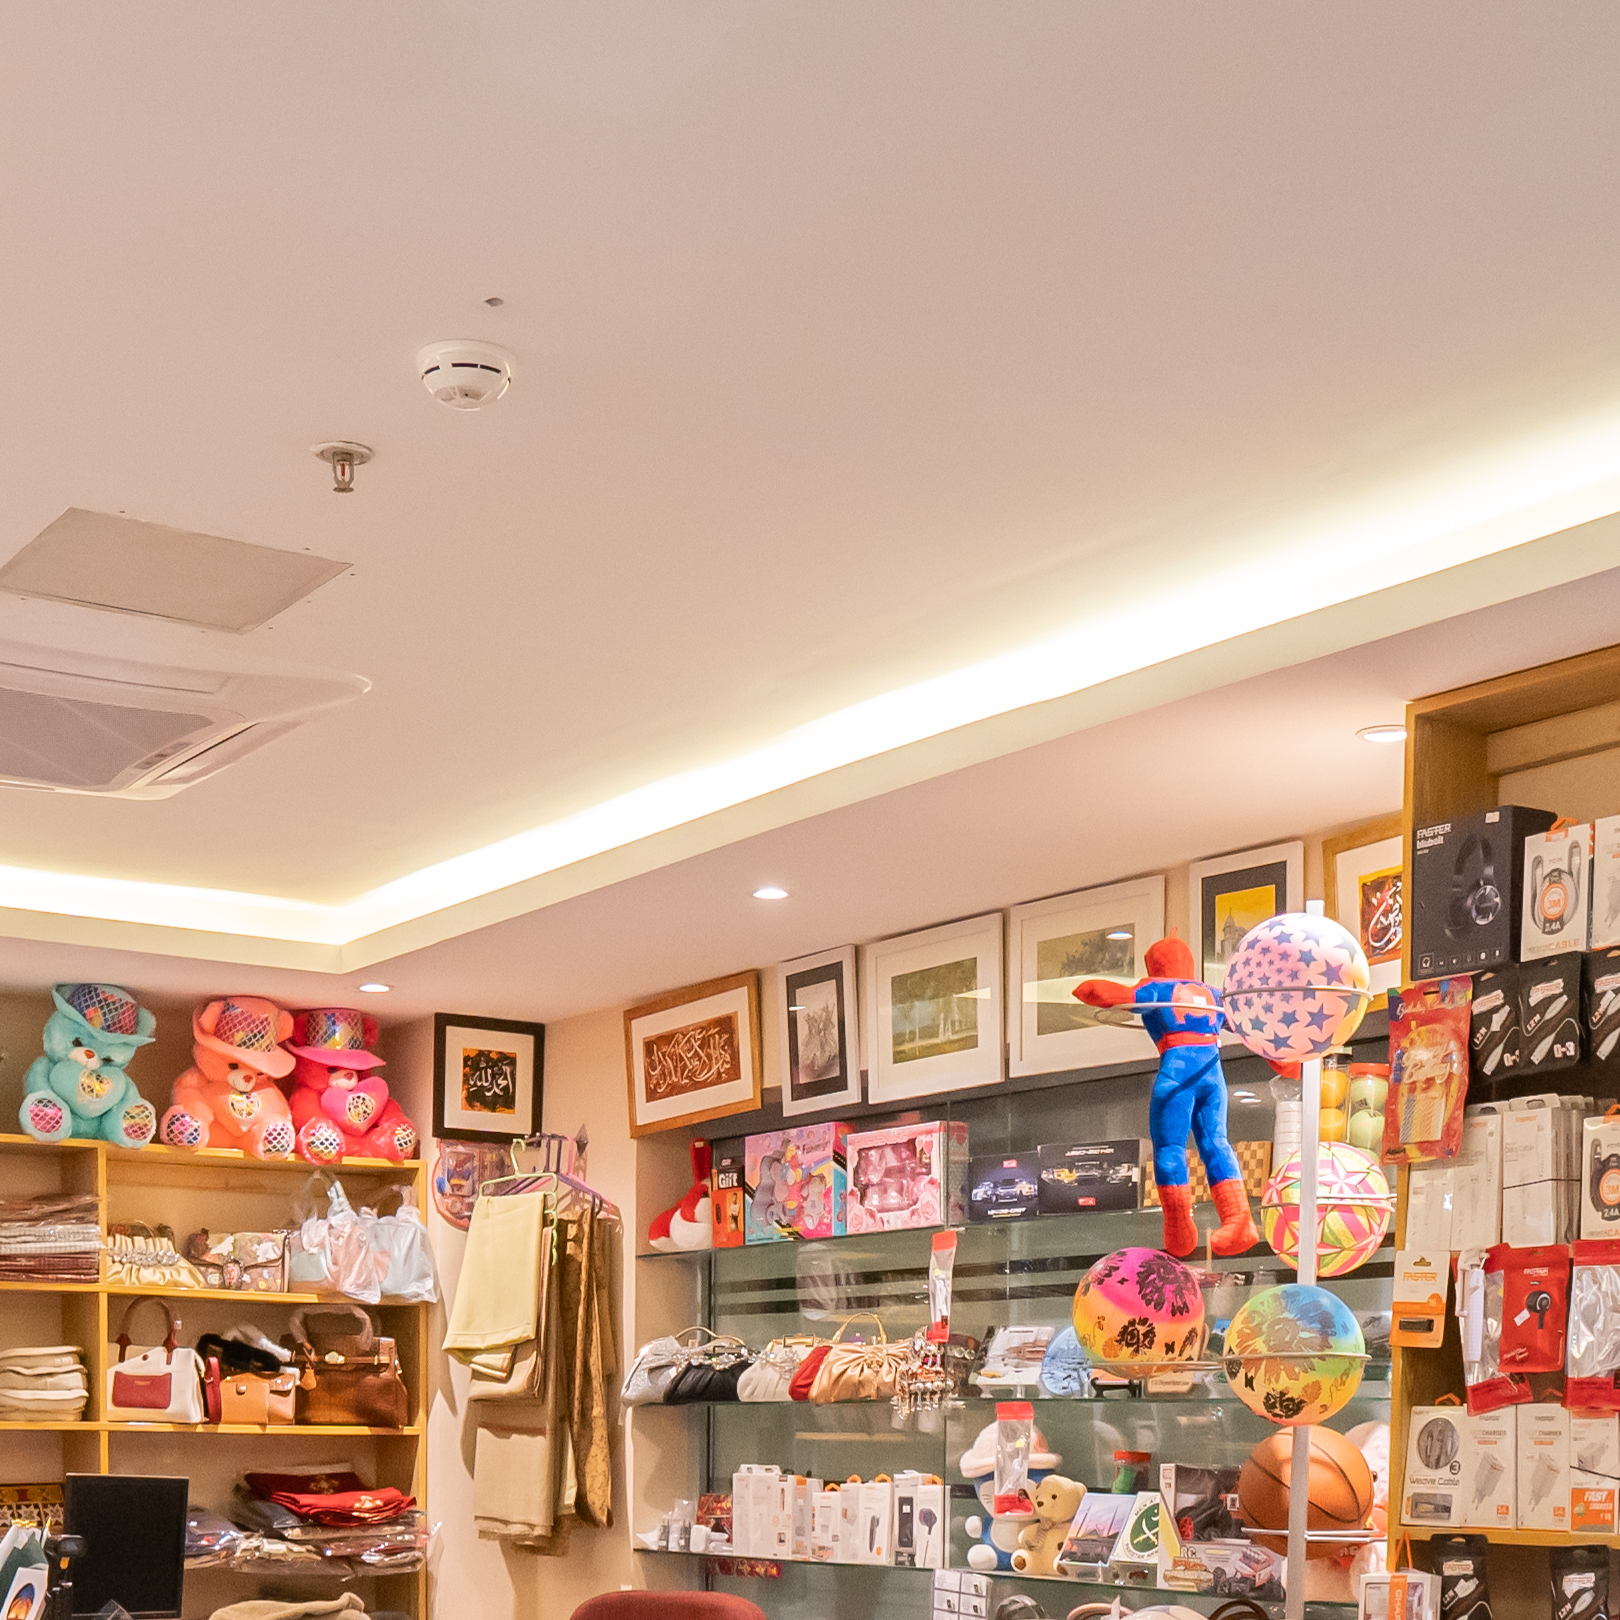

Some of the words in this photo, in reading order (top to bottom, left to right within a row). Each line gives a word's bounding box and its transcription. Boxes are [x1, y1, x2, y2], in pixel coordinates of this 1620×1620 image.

[1417, 823, 1452, 839] FASTER
[718, 1172, 738, 1188] Gift
[1403, 1271, 1438, 1282] FASTER
[1437, 1477, 1460, 1487] Cable
[1584, 1491, 1609, 1502] FAST
